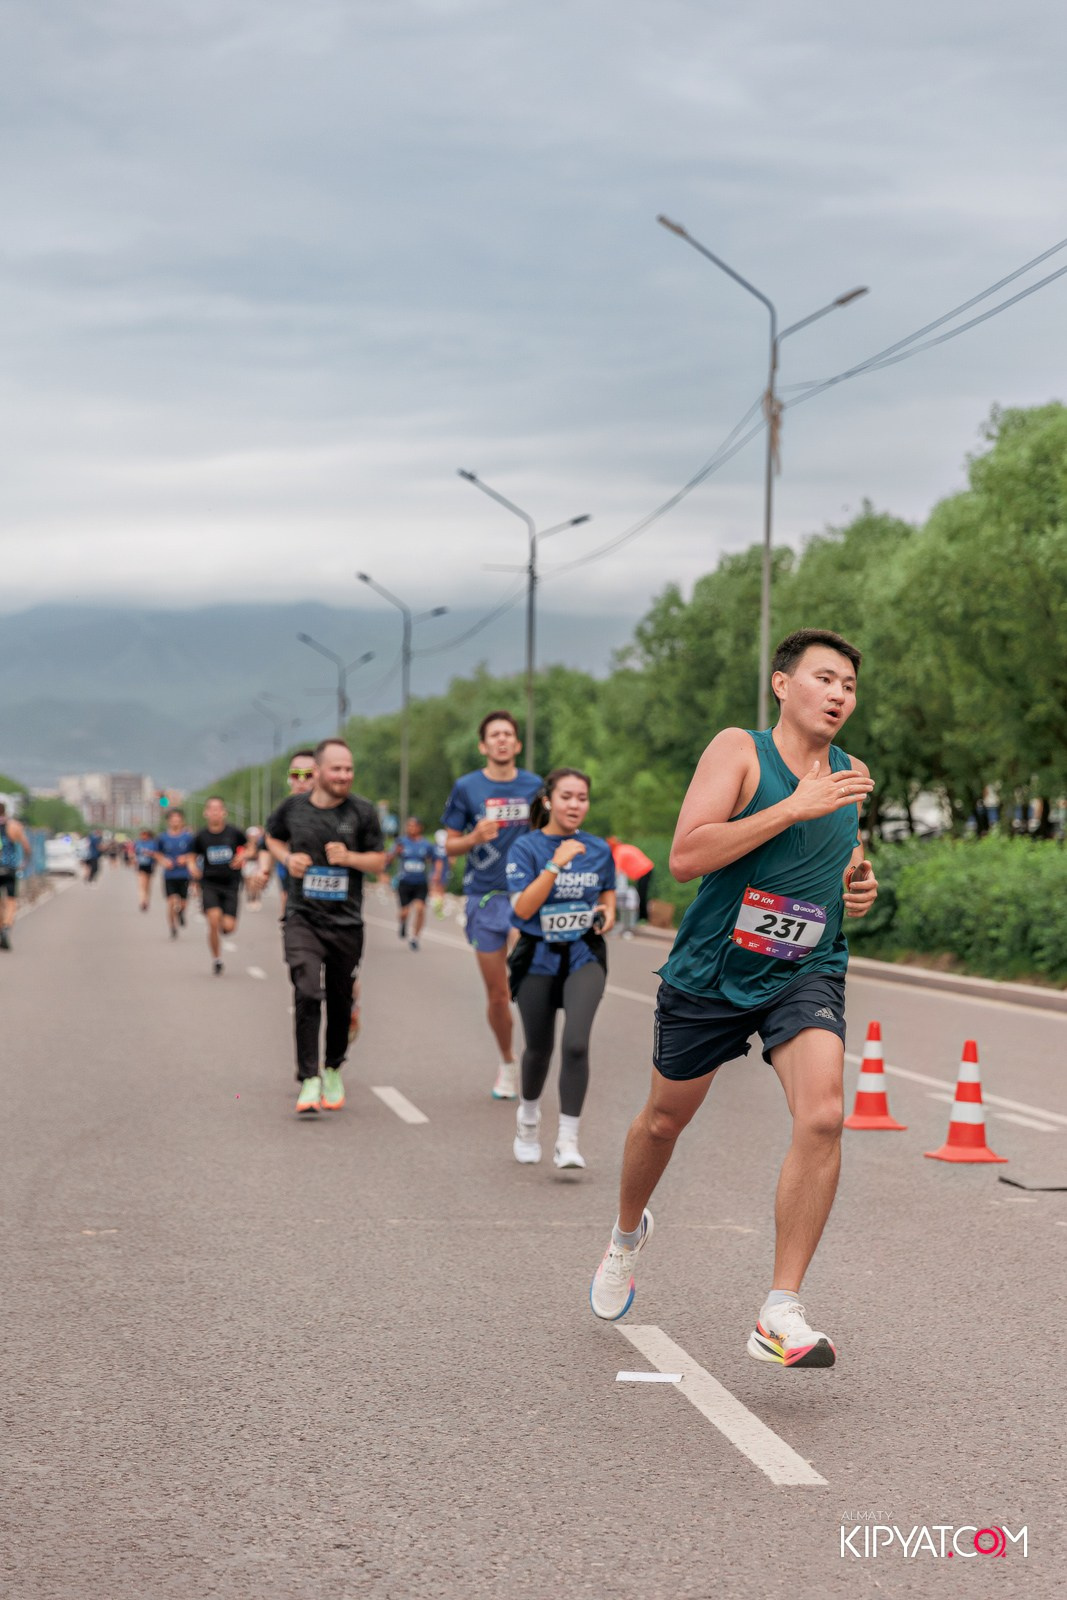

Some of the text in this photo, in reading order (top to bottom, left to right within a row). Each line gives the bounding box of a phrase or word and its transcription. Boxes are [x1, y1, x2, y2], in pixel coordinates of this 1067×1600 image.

[554, 887, 584, 899] 2025
[748, 892, 775, 905] 10 KM
[548, 914, 588, 930] 1076
[754, 914, 807, 942] 231
